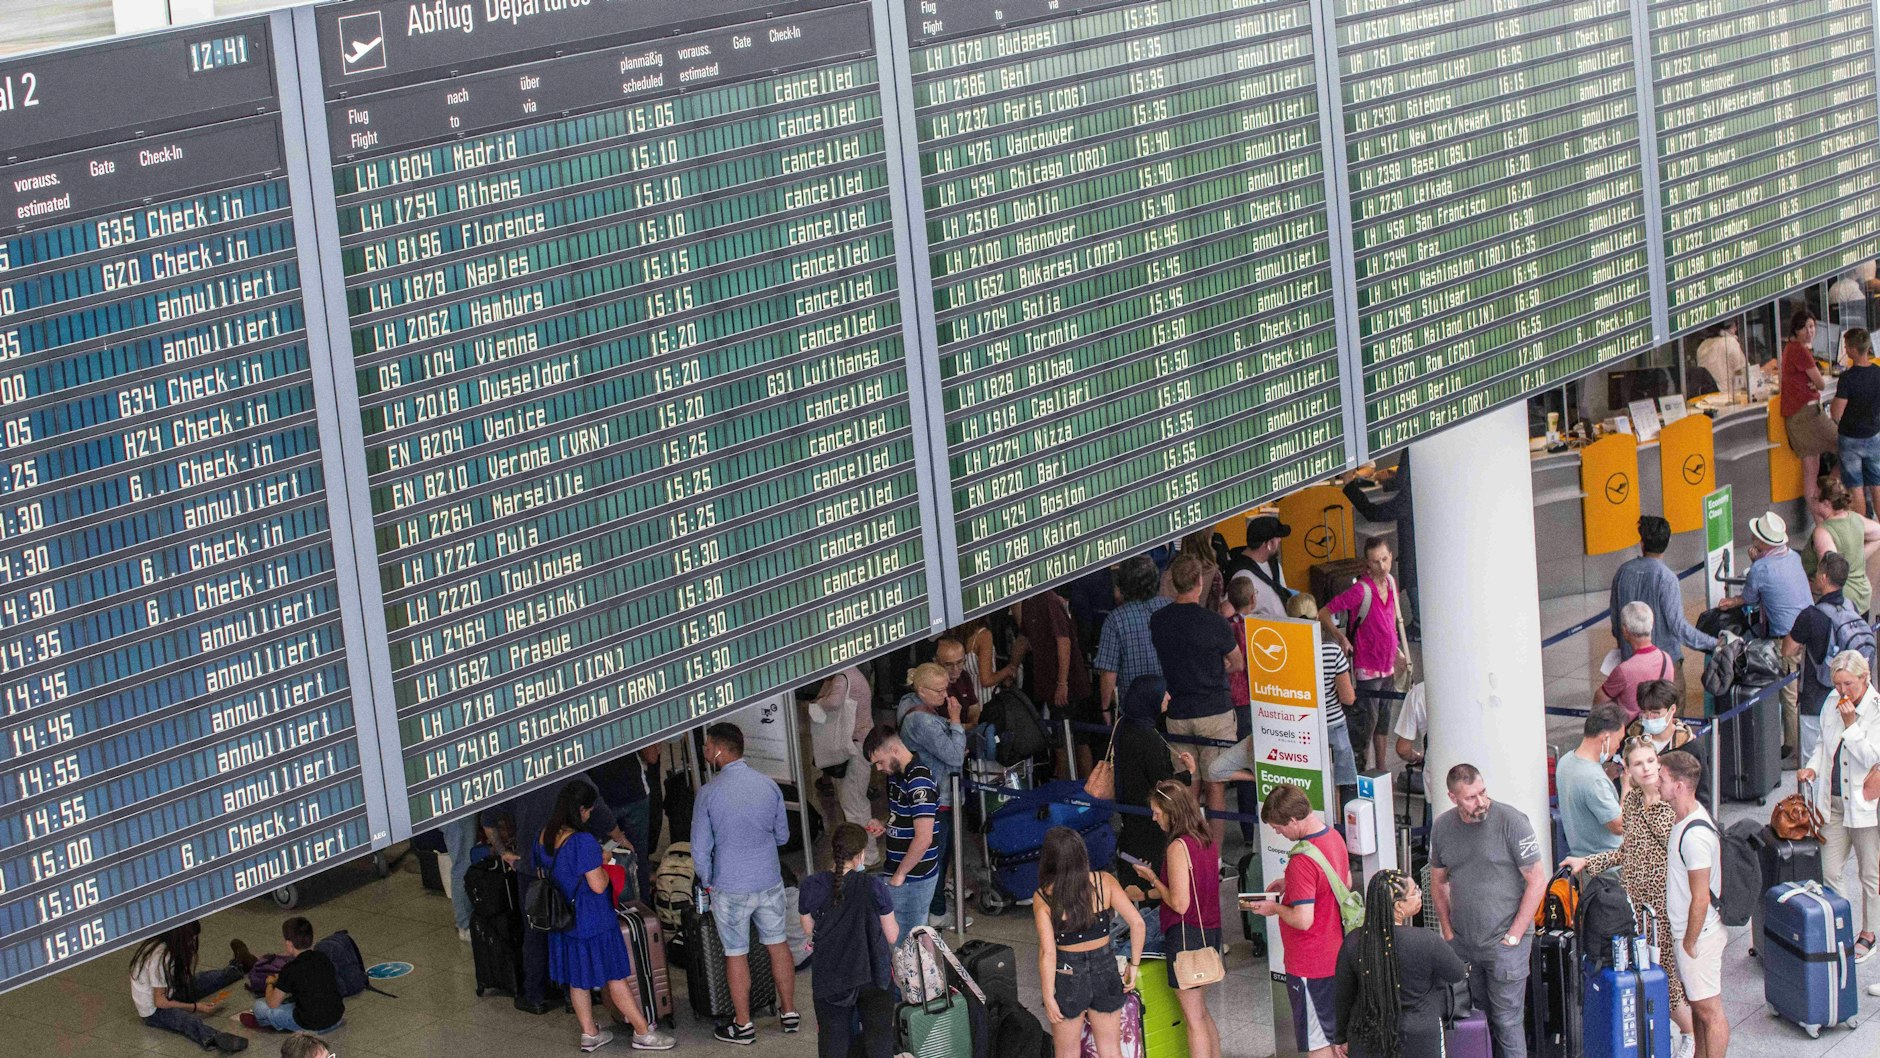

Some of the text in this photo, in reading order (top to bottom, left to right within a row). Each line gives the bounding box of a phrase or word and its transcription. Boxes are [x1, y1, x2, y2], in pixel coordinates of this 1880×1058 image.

[407, 4, 474, 36] Abflug
[921, 2, 937, 14] Flug
[732, 25, 801, 50] Gate Check-In
[923, 20, 943, 35] Flight
[997, 26, 1057, 55] Budapest
[1402, 18, 1520, 61] Denver 16:05
[191, 35, 247, 71] 12:41
[620, 44, 712, 74] planmäßig vorauss.
[21, 72, 40, 107] 2
[447, 75, 540, 105] nach über
[622, 63, 719, 94] scheduled estimated
[1000, 64, 1030, 89] Genf
[1404, 68, 1438, 90] London
[348, 108, 369, 125] Flug
[351, 99, 537, 149] Flight to via
[1003, 97, 1042, 122] Paris
[356, 67, 852, 191] LH 1804 Madrid 15:05 cancelled
[1007, 126, 1073, 154] Vancouver
[89, 145, 183, 177] Gate Check-In
[1010, 162, 1063, 188] Chicago
[14, 173, 60, 193] vorauss.
[458, 179, 520, 209] Athens
[942, 128, 1307, 241] LH 2518 Dublin 15:40 annulliert
[16, 194, 71, 219] estimated
[98, 196, 243, 248] G35 Check-in
[369, 172, 862, 311] LH 1878 Naples 15:10 cancelled
[462, 213, 544, 248] Florence
[1016, 225, 1075, 254] Hannover
[103, 238, 248, 290] G20 Check-in
[1417, 241, 1440, 260] Graz
[1019, 253, 1078, 287] Bukarest
[158, 271, 273, 321] annulliert
[471, 292, 543, 325] Hamburg
[1022, 294, 1060, 320] Sofia
[164, 312, 278, 363] annulliert
[383, 276, 873, 430] LH 2018 Dusseldorf 15:20 cancelled
[475, 332, 537, 364] Vienna
[1025, 322, 1077, 352] Toronto
[119, 361, 262, 417] G34 Check-in
[1028, 358, 1073, 386] Bilbao
[1427, 342, 1544, 401] Berlin 17:00
[1031, 382, 1089, 418] Cagliari
[1379, 330, 1643, 449] LH 2214 Paris 17:10 annulliert
[124, 402, 268, 459] H24 Check-in
[392, 350, 879, 509] EN 8210 Verona 15:20 G31 Lufthansa
[484, 409, 545, 441] Venice
[968, 364, 1326, 508] EN 8220 Bari 15:55 annulliert
[1034, 425, 1072, 451] Nizza
[179, 443, 272, 487] Check-in
[185, 474, 298, 529] annulliert
[492, 474, 583, 518] Marseille
[1040, 486, 1085, 515] Boston
[190, 524, 283, 570] Check-in
[496, 526, 538, 556] Pula
[978, 452, 1332, 607] LH 1982 Köln / Bonn 15:55 annulliert
[1043, 520, 1080, 548] Kairo
[411, 482, 892, 664] LH 2464 Helsinki 15:30 cancelled
[501, 553, 581, 593] Toulouse
[0, 565, 288, 672] 14:35 Check-in
[6, 594, 313, 715] 14:45 annulliert
[421, 549, 899, 741] LH 718 Seoul 15:30 cancelled
[510, 633, 570, 669] Prague
[12, 634, 318, 757] 14:45 annulliert
[1254, 681, 1312, 701] Lufthansa
[430, 617, 905, 817] LH 2370 Zurich 15:30 cancelled
[519, 696, 608, 743] Stockholm
[1257, 706, 1296, 722] Austrian
[19, 673, 323, 799] 14:55 annulliert
[1261, 726, 1296, 739] brussels
[1278, 751, 1309, 764] SWISS
[25, 713, 328, 841] 14:55 annulliert
[1260, 769, 1312, 790] Economy
[32, 752, 334, 882] 15:00 annulliert
[38, 802, 319, 923] 15:05 Check-in
[45, 829, 345, 964] 15:05 annulliert
